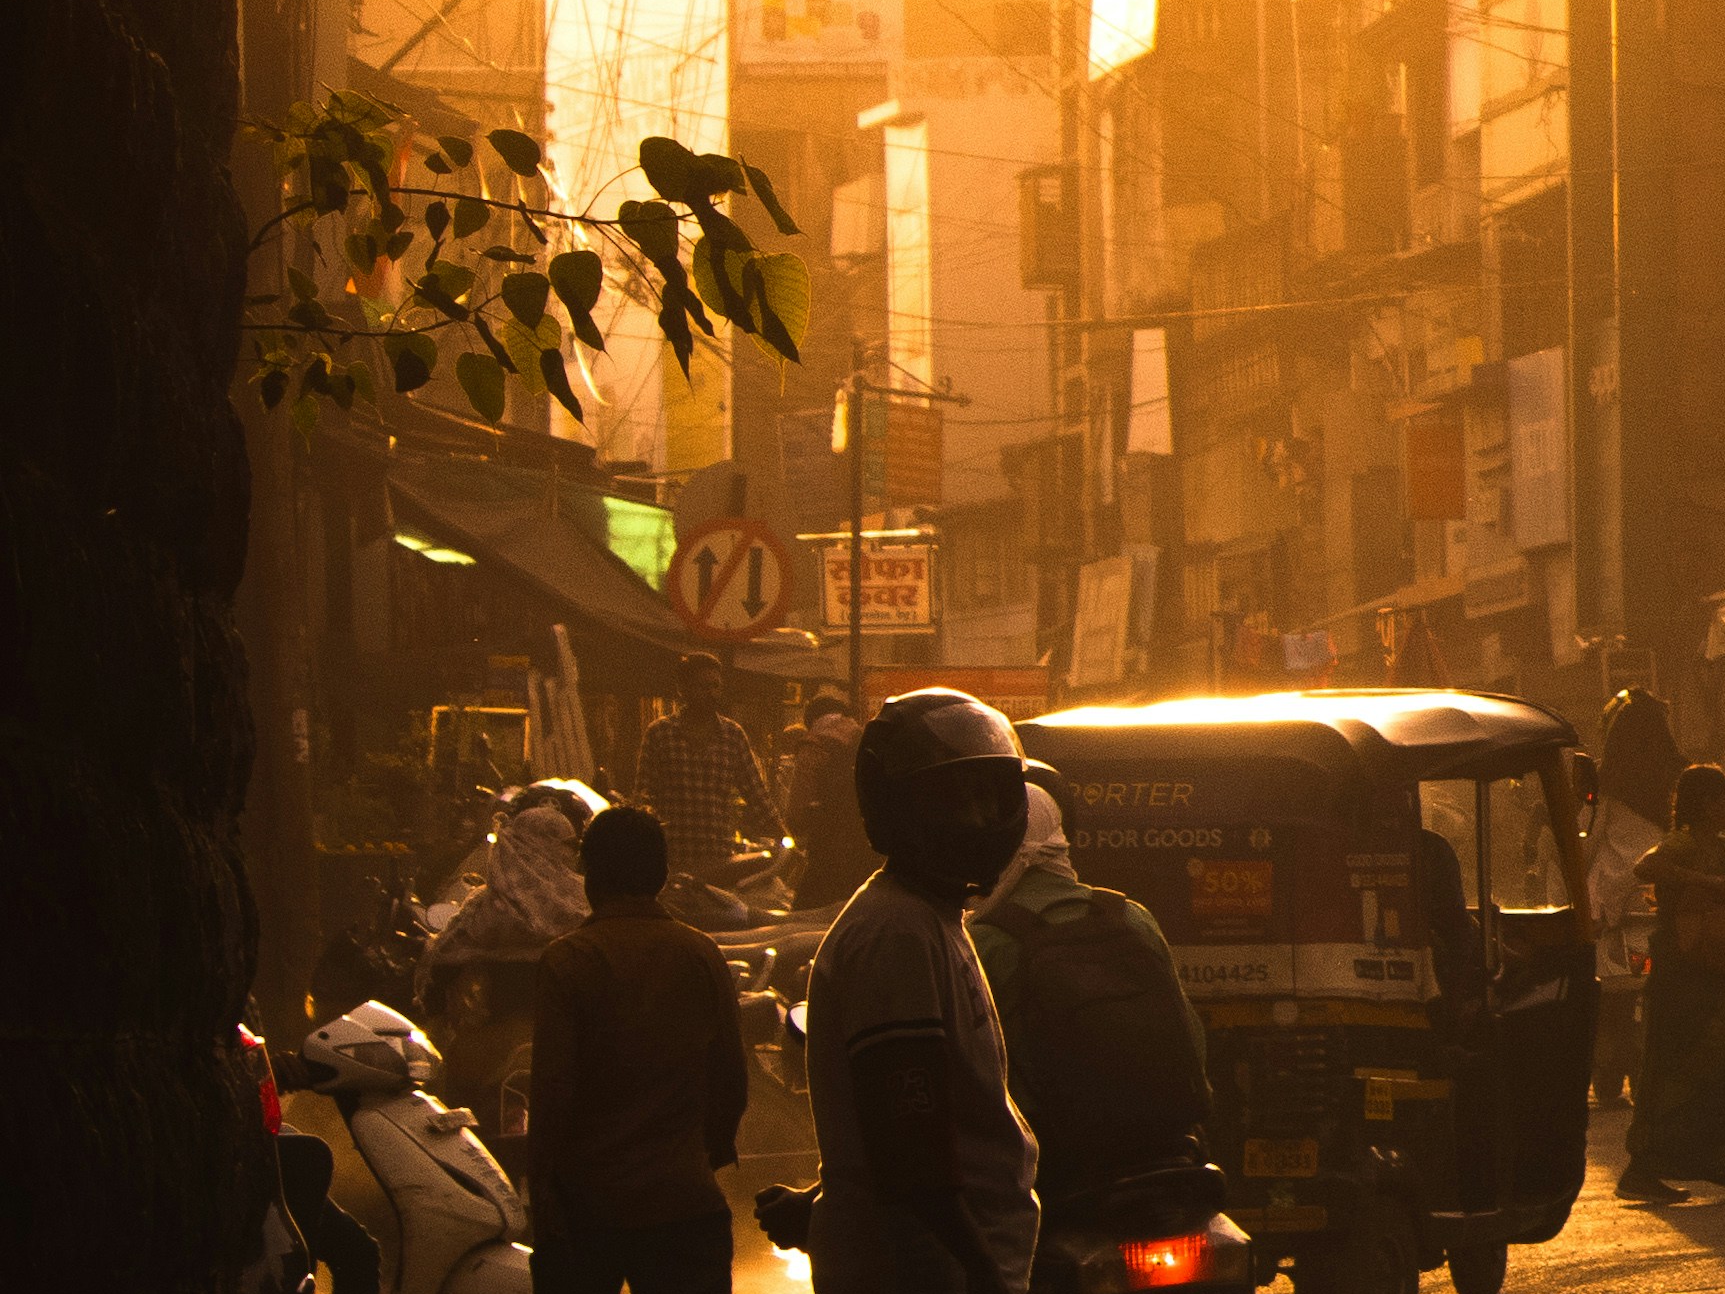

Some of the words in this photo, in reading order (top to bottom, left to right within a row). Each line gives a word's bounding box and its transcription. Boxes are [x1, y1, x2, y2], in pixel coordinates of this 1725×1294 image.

[1099, 829, 1137, 848] FOR
[1143, 827, 1223, 848] GOODS
[1203, 870, 1263, 894] 50%
